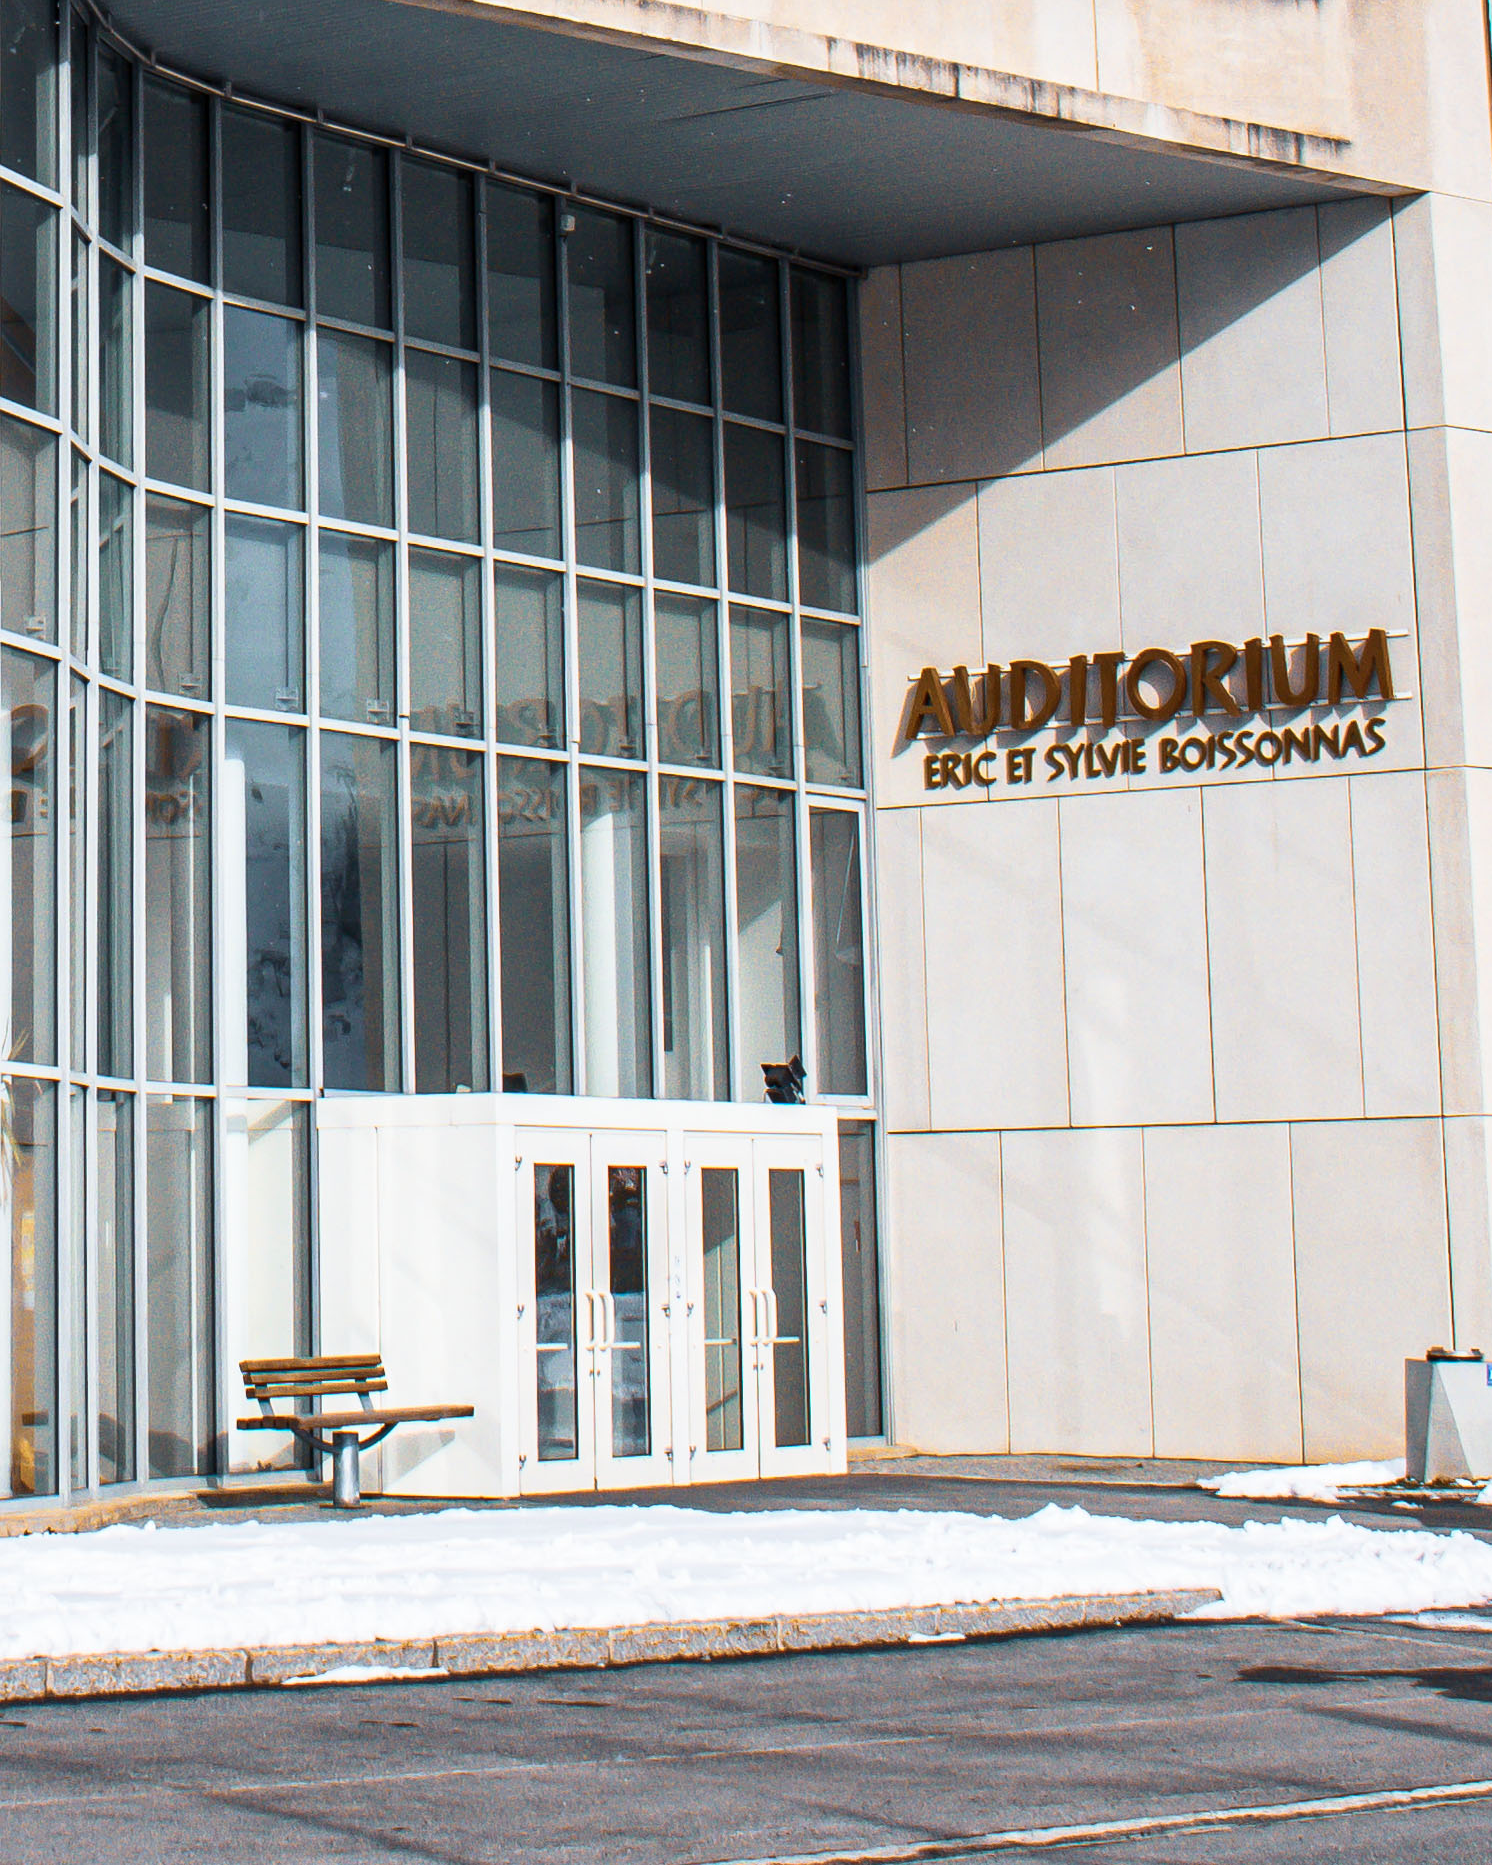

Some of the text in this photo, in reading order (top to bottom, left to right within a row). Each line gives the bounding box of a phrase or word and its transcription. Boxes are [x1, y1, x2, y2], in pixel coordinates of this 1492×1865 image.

[903, 629, 1395, 740] AUDITORIUM
[924, 719, 1387, 791] ERIC ET SYLVIE BOISSONNAS
